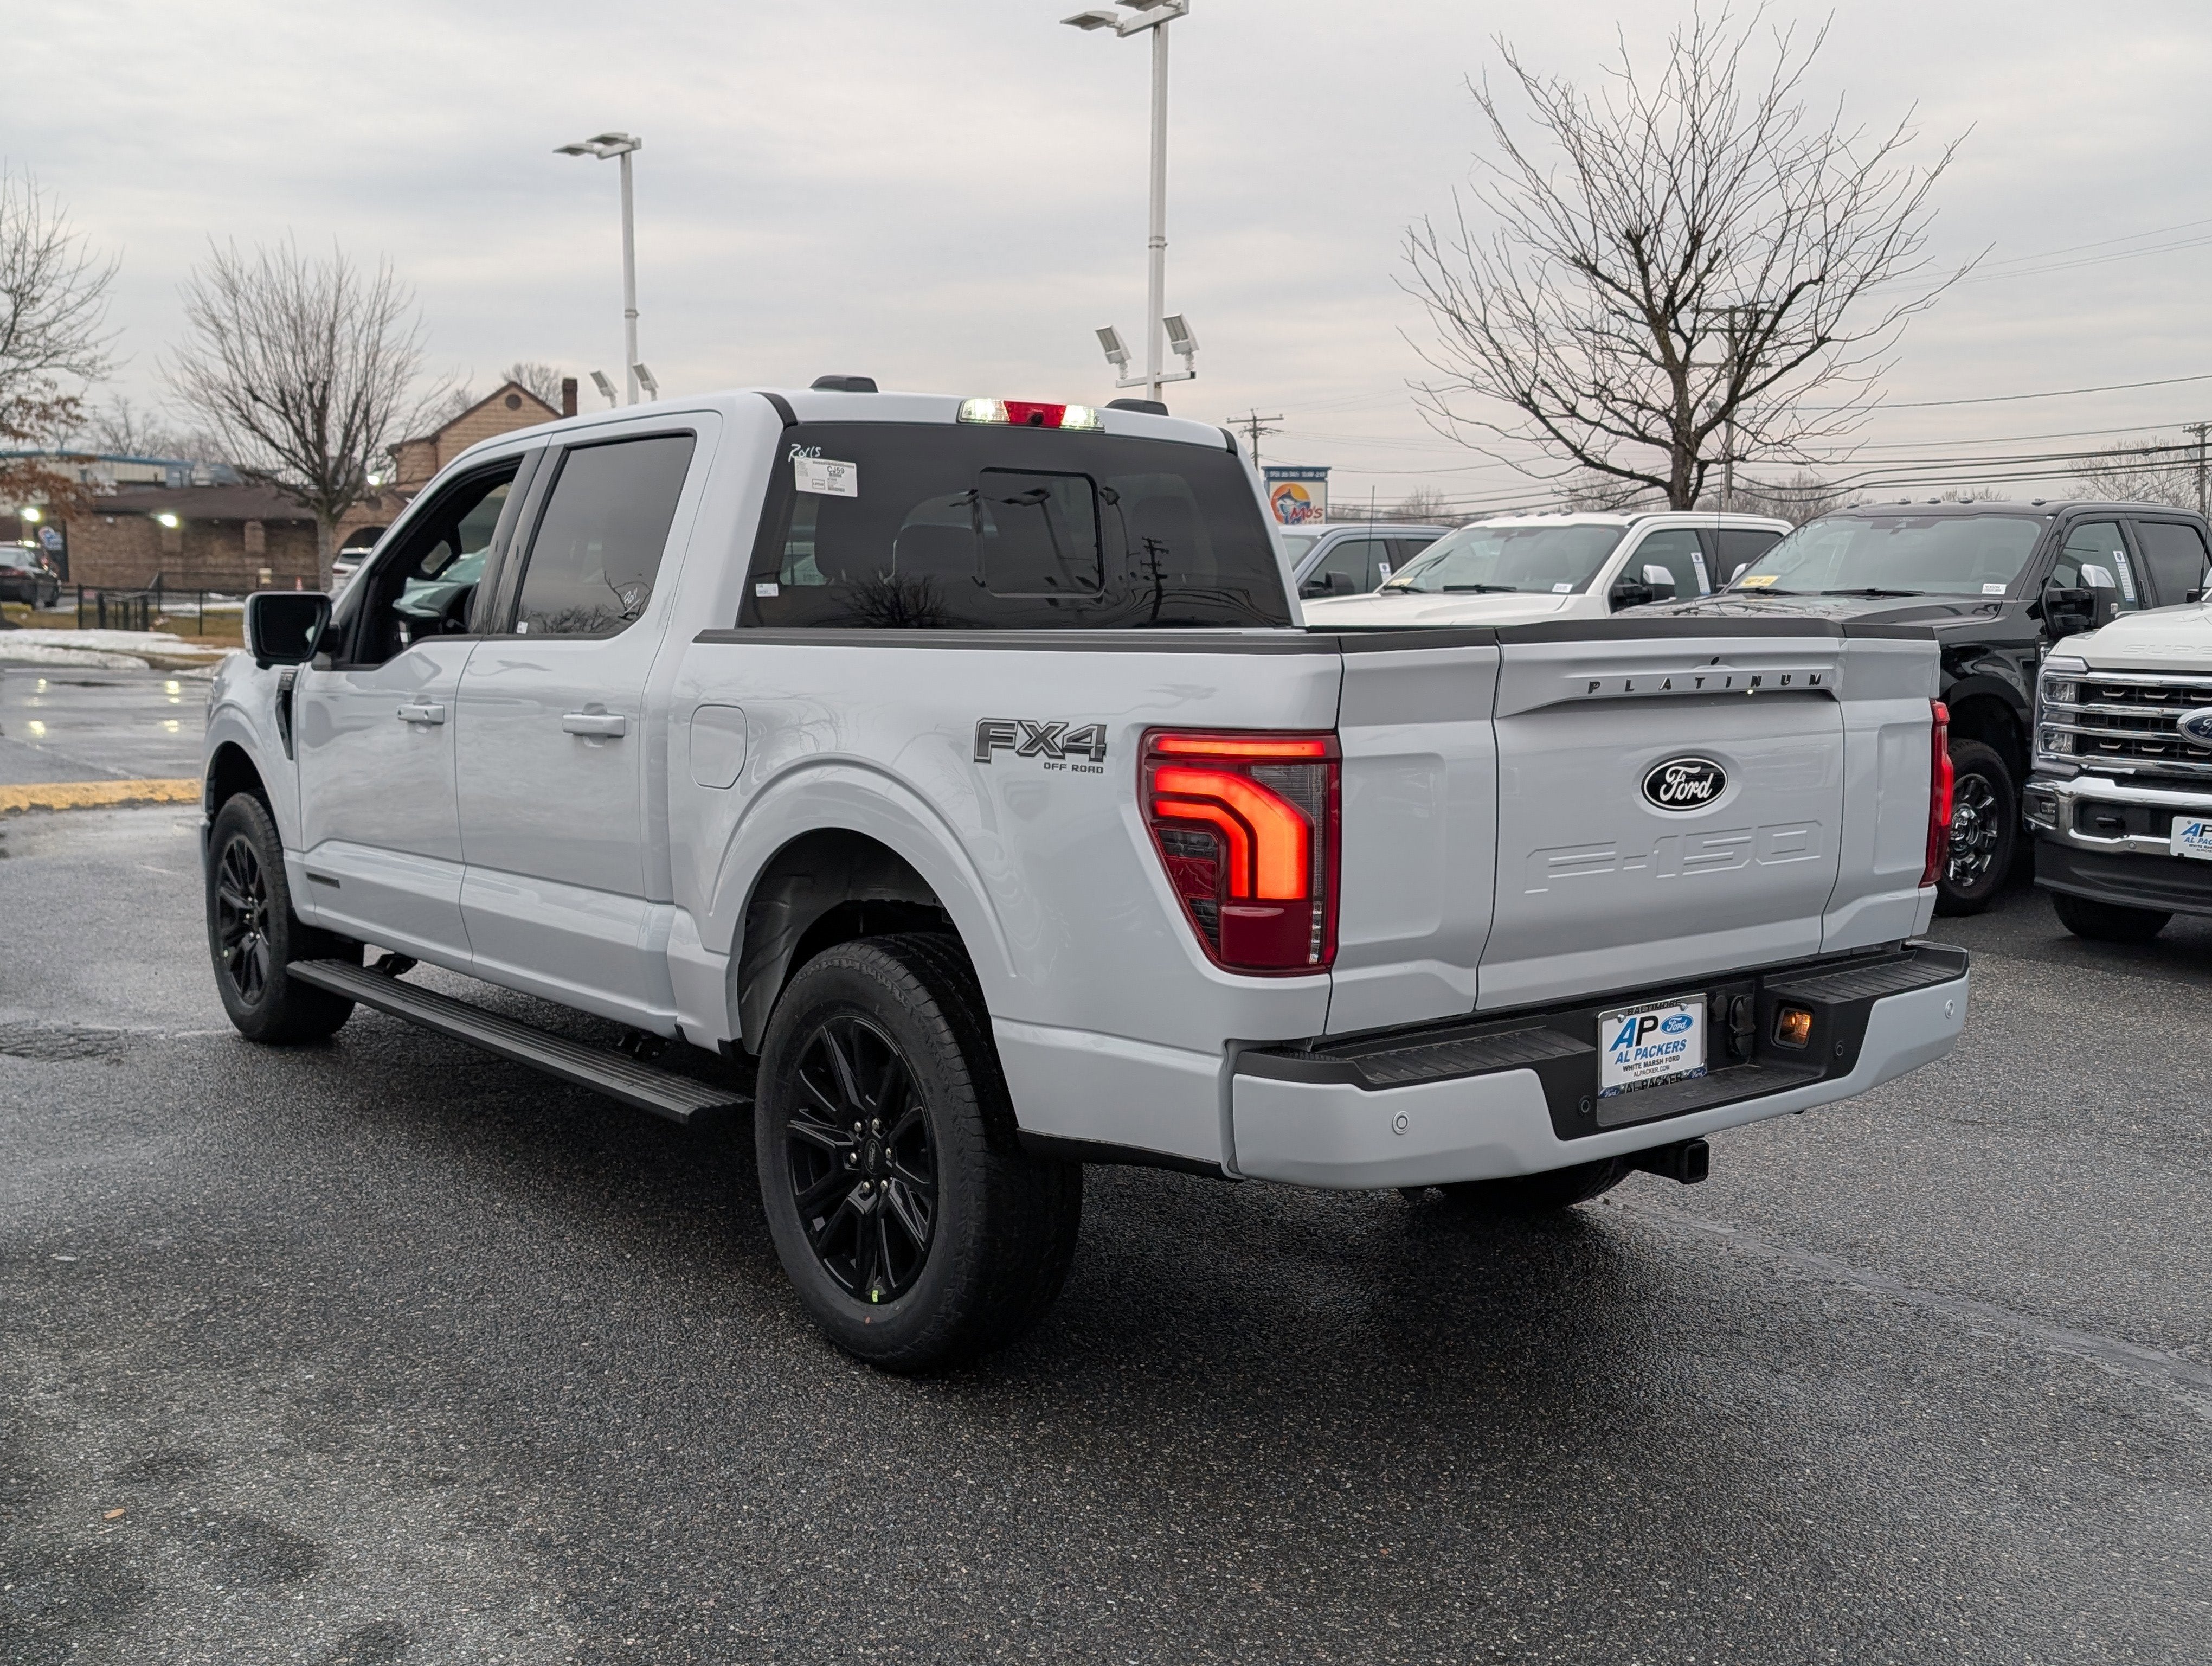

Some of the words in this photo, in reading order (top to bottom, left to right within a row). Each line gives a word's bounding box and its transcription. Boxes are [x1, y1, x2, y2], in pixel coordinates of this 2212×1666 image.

[1588, 673, 1821, 694] PLATINUM
[973, 717, 1107, 764] FX4
[1043, 762, 1068, 771] OFF
[1071, 764, 1104, 774] ROAD
[1659, 766, 1713, 802] Ford
[1525, 819, 1823, 893] F-150
[1628, 999, 1681, 1015] BALTIMORE
[1609, 1015, 1659, 1052] AP
[1667, 1017, 1687, 1031] Ford
[1615, 1050, 1630, 1065] AL
[1634, 1039, 1687, 1061] PACKERS
[1623, 1062, 1642, 1072] WHITE
[1643, 1057, 1664, 1068] MARSH
[1665, 1054, 1680, 1063] FORD
[1633, 1064, 1670, 1077] ALPACKER.COM
